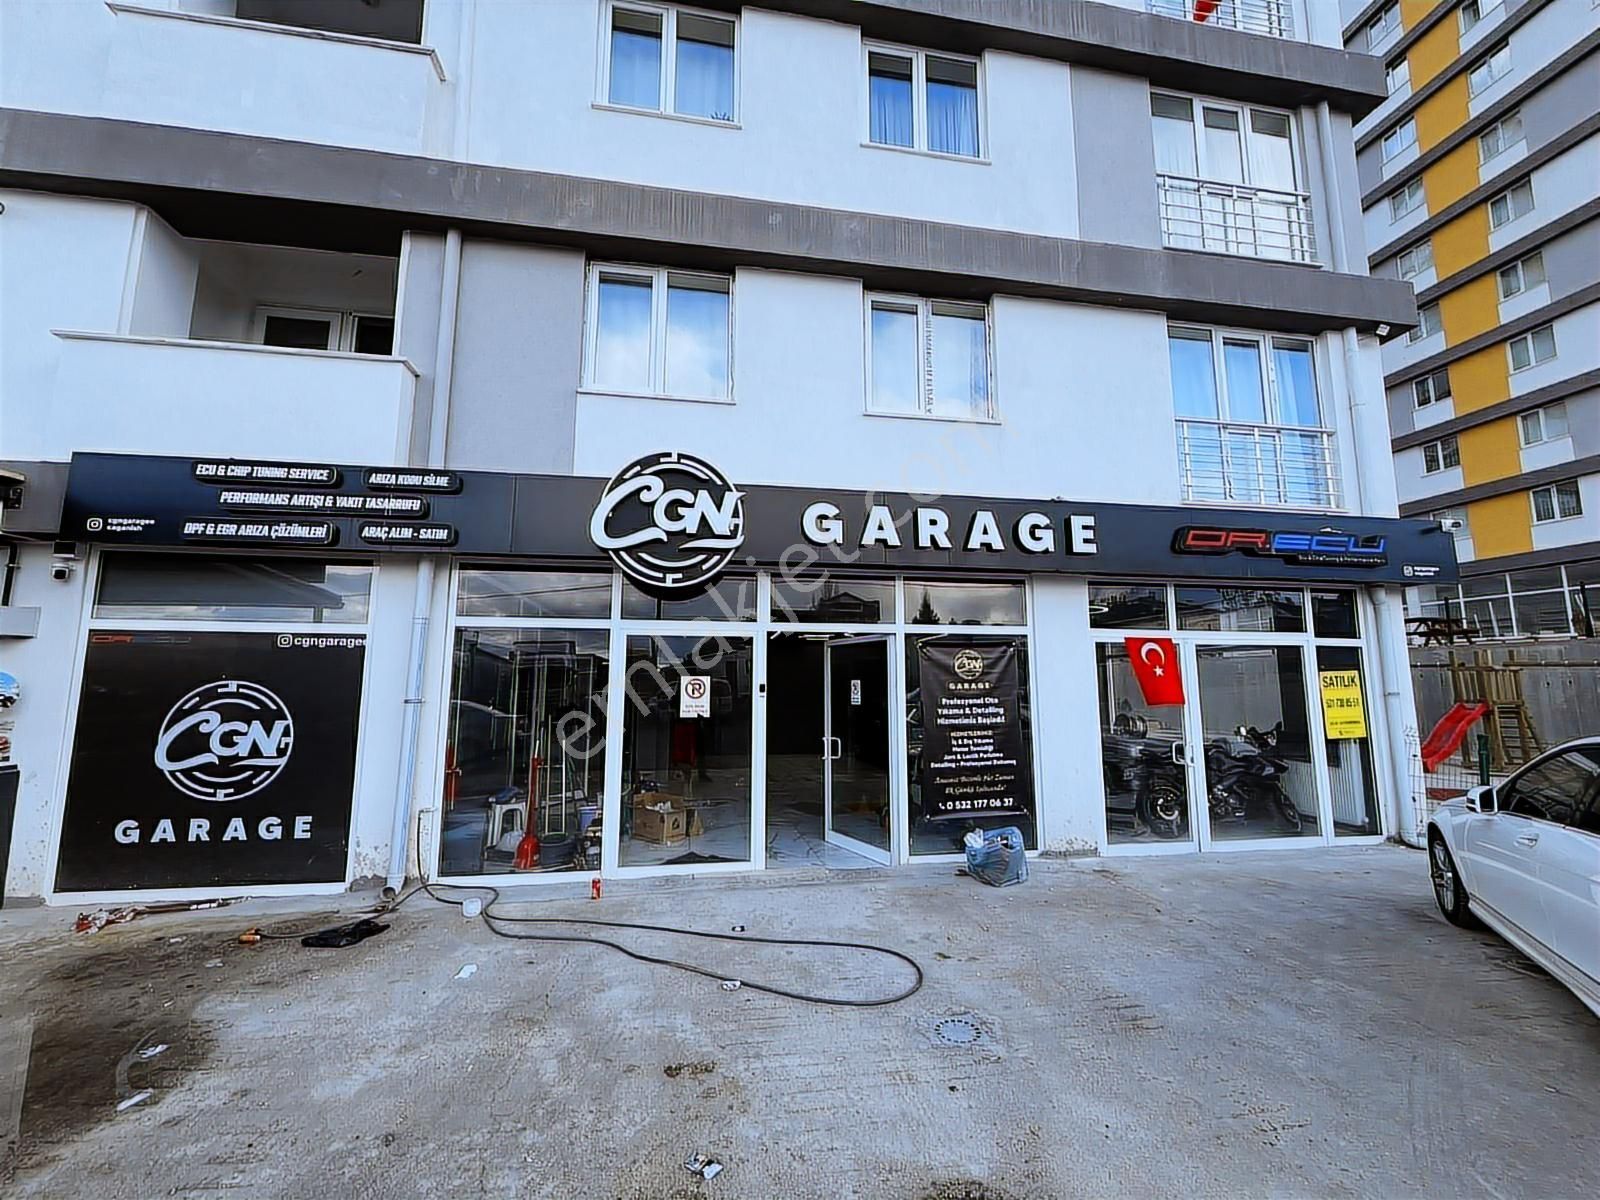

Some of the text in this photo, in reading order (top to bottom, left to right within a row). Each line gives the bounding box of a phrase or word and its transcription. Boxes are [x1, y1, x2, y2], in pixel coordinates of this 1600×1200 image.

[196, 464, 330, 480] ECU & CHIP TUNING SERVICE
[369, 473, 396, 484] ARIZA
[220, 491, 420, 510] PERFORMANS ARTIŞI & YAKIT TASARRUFU
[184, 522, 328, 539] DPF & EGR ARIZA ÇÖZÜMLERİ
[362, 526, 389, 541] ARAÇ
[389, 527, 413, 538] ALIM
[419, 528, 448, 539] SATIM
[801, 501, 1097, 554] GARAGE
[949, 682, 990, 690] GARAGE
[1322, 675, 1357, 688] SATILIK
[941, 697, 983, 705] Profesyonel
[972, 706, 1004, 715] Detailing
[946, 797, 1014, 810] 0 532 177 06 37
[114, 816, 313, 844] GARAGE
